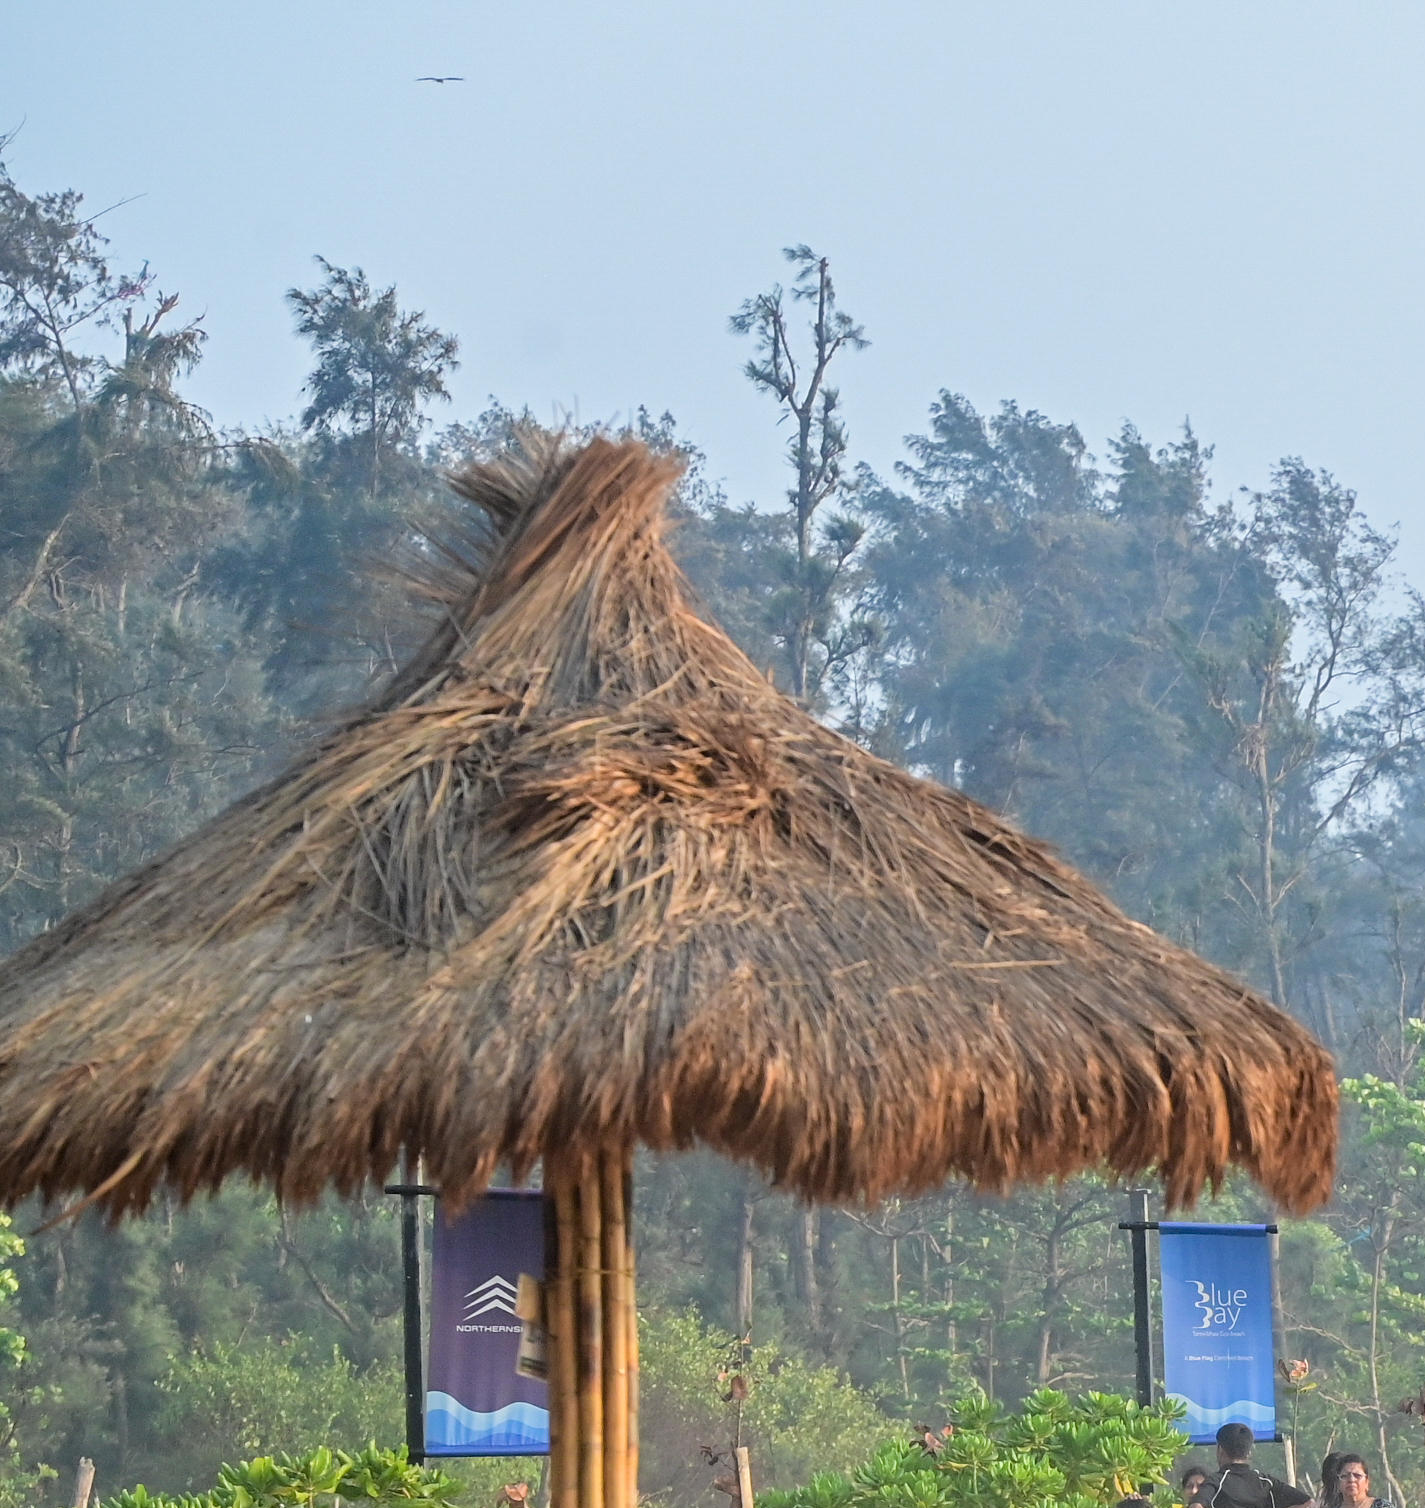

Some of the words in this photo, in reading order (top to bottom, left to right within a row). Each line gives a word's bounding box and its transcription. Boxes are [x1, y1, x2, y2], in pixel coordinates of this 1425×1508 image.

[1185, 1280, 1247, 1307] Blue
[456, 1325, 524, 1333] NORTHERNS
[1192, 1306, 1241, 1330] Bay
